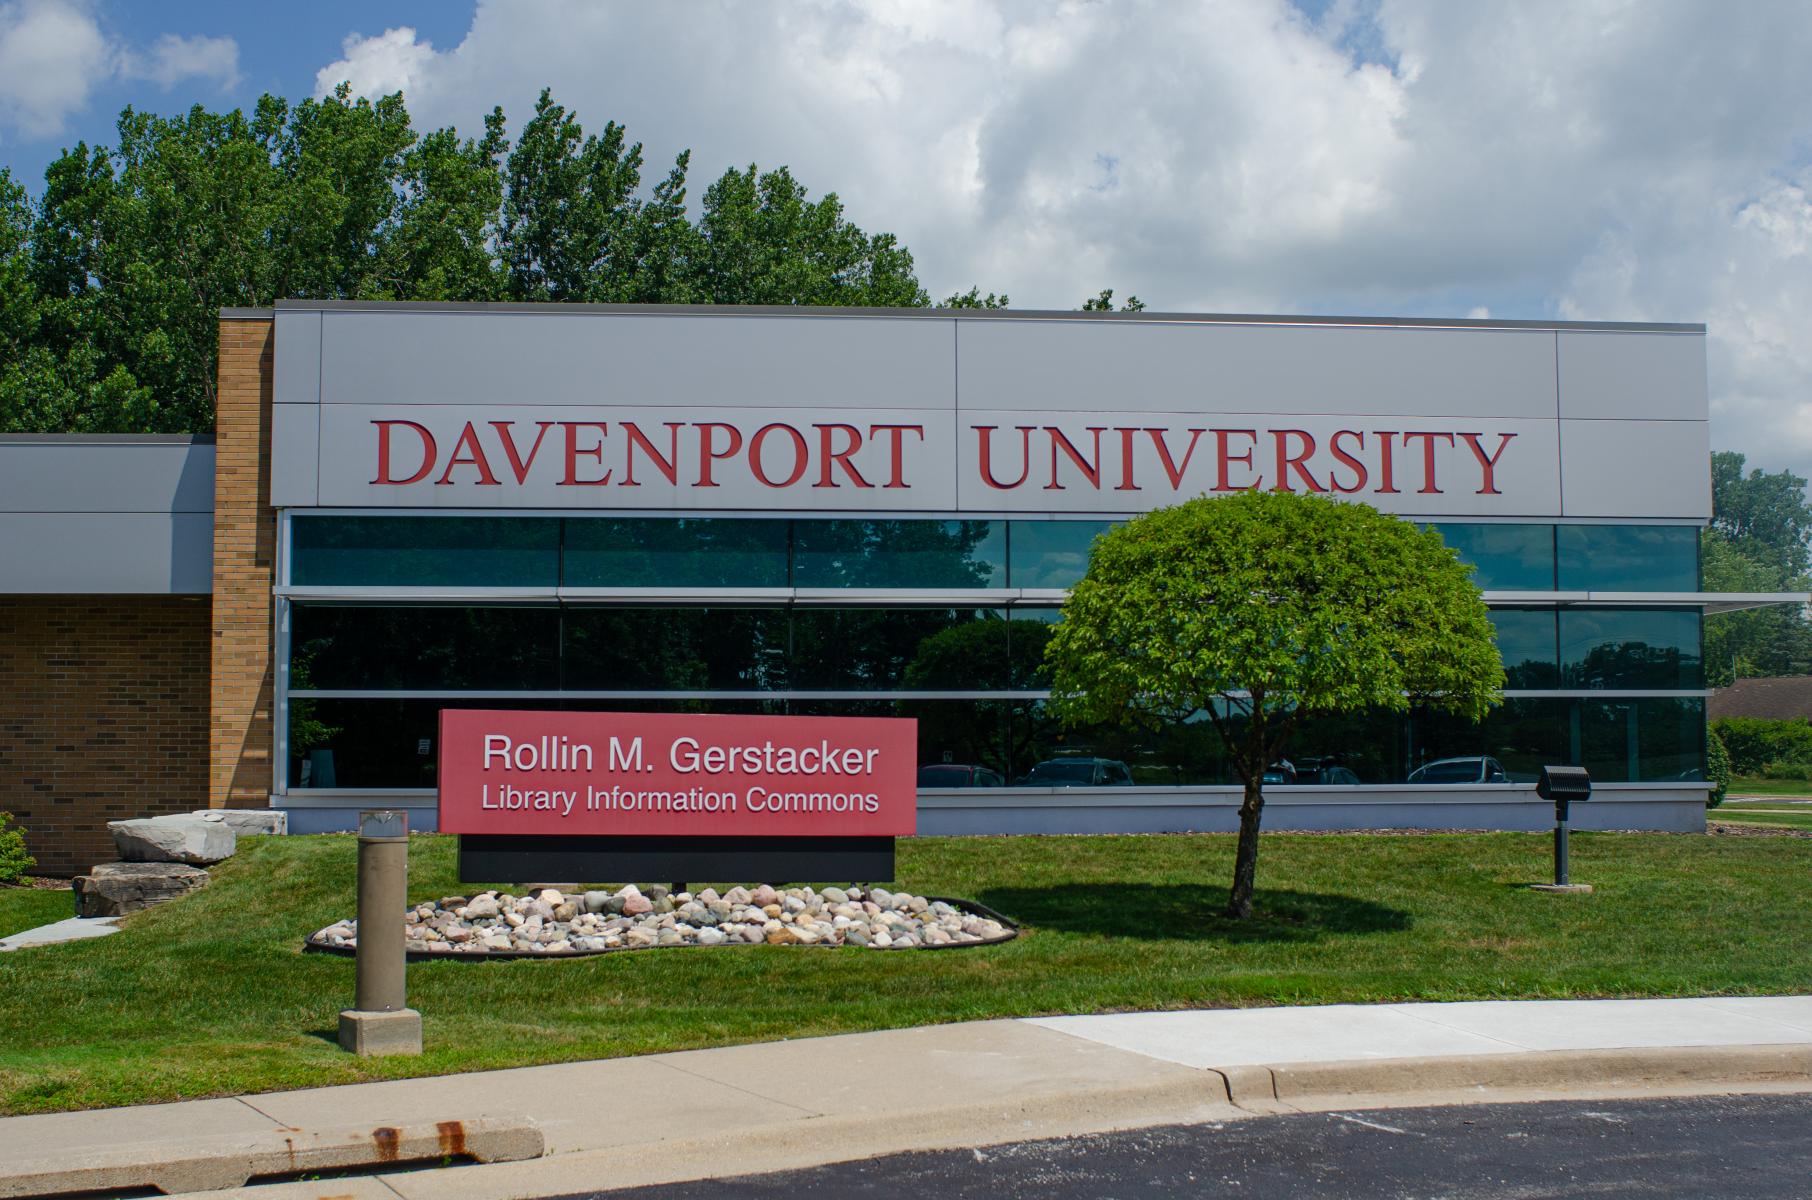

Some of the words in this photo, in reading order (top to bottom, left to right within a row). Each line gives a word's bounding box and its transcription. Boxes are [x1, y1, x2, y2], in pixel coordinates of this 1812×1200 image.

[368, 419, 925, 489] DAVENPORT
[970, 425, 1519, 495] UNIVERSITY
[483, 733, 593, 770] Rollin
[608, 736, 654, 772] M.
[669, 736, 880, 774] Gerstacker
[481, 783, 577, 816] Library
[586, 785, 737, 811] Information
[745, 786, 879, 812] Commons
